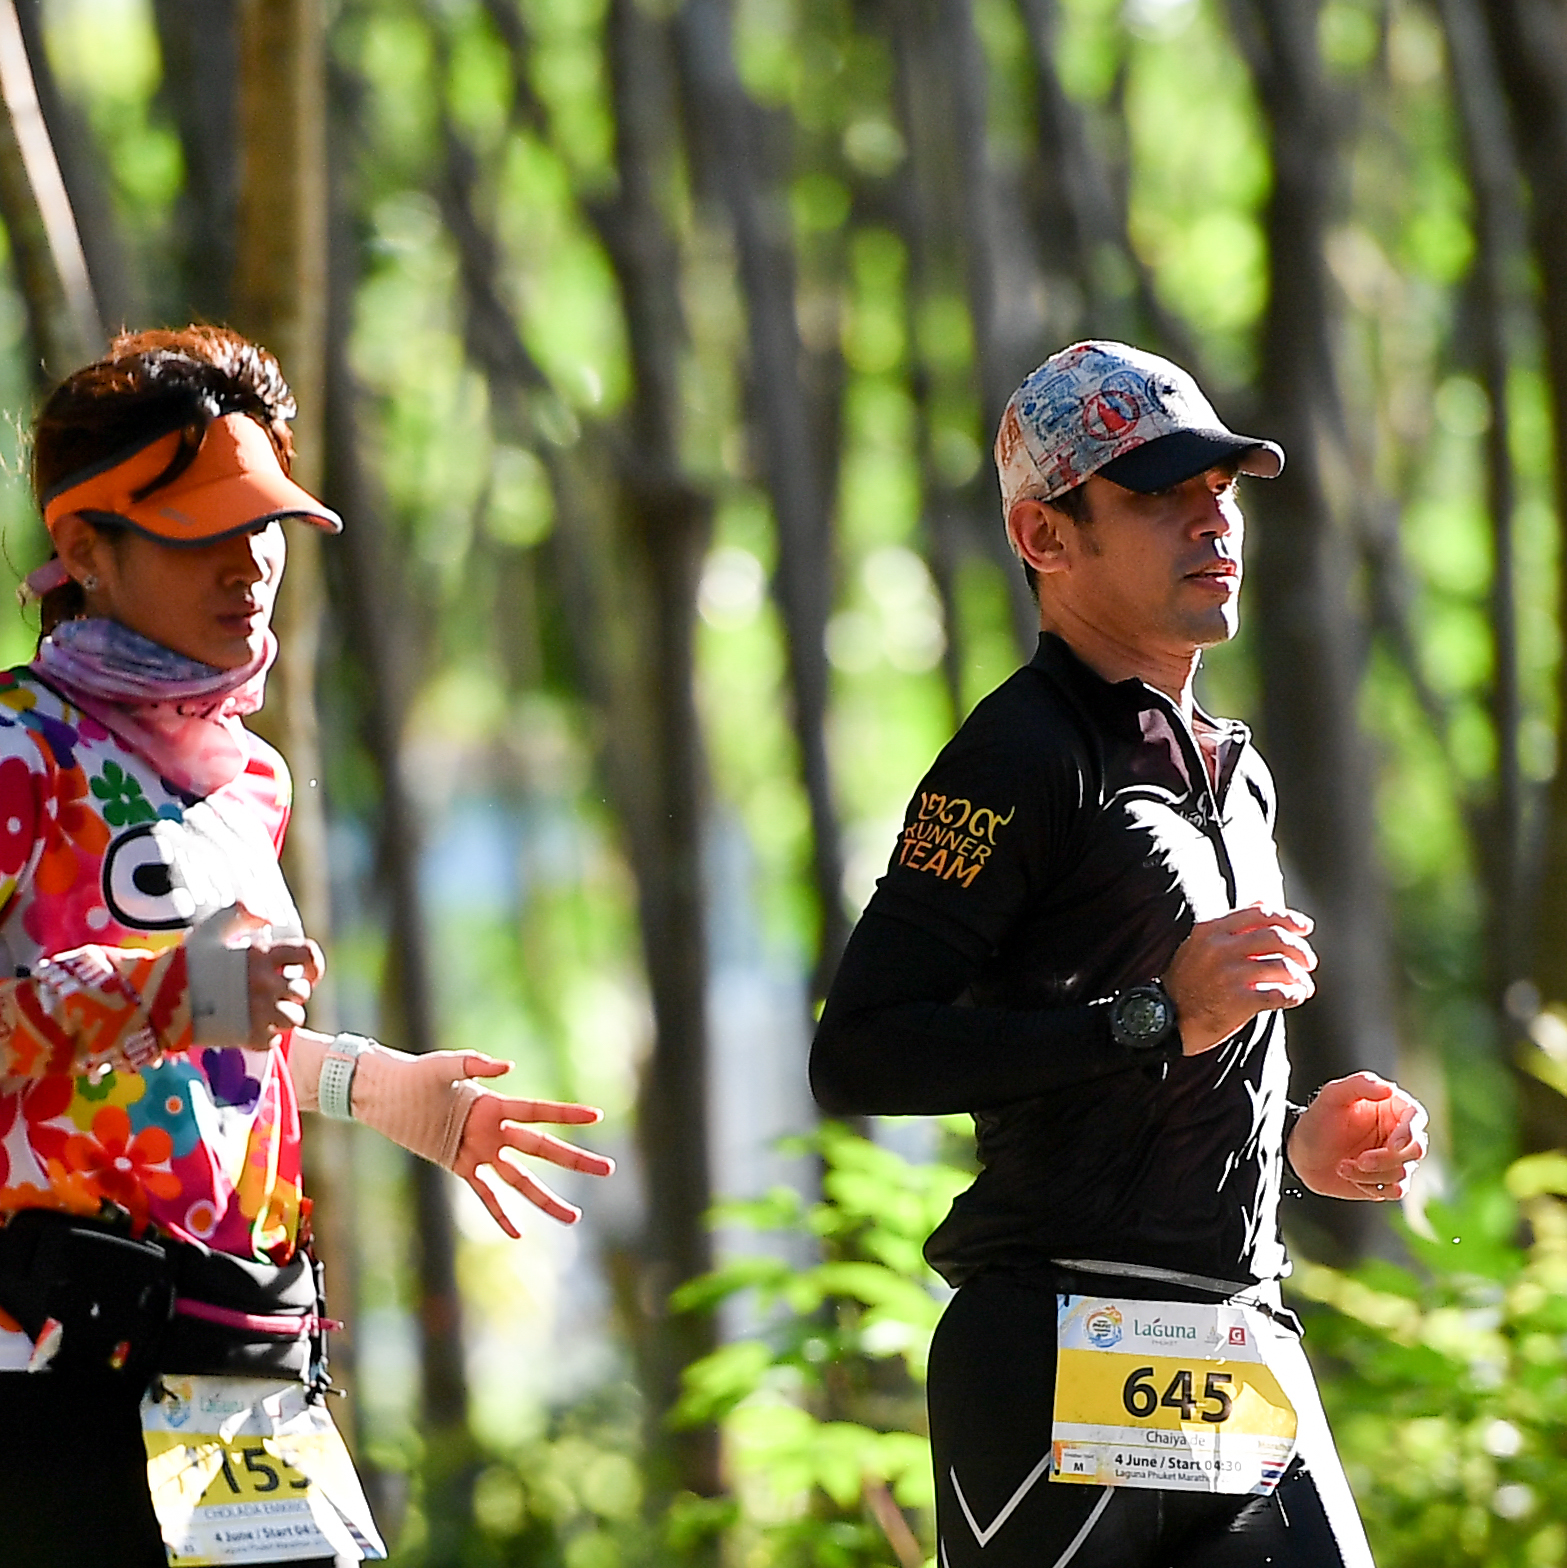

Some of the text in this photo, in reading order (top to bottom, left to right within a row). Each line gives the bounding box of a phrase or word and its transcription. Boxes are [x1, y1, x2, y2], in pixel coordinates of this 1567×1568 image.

[904, 822, 992, 865] RUNNER
[898, 838, 983, 888] TEAM
[1122, 1366, 1233, 1423] 645
[1073, 1462, 1084, 1472] M
[1114, 1453, 1123, 1465] 4
[1125, 1454, 1157, 1468] June
[1167, 1456, 1201, 1471] Start
[1204, 1460, 1242, 1472] 04:30
[1115, 1469, 1213, 1482] Laguna Phuket Marath
